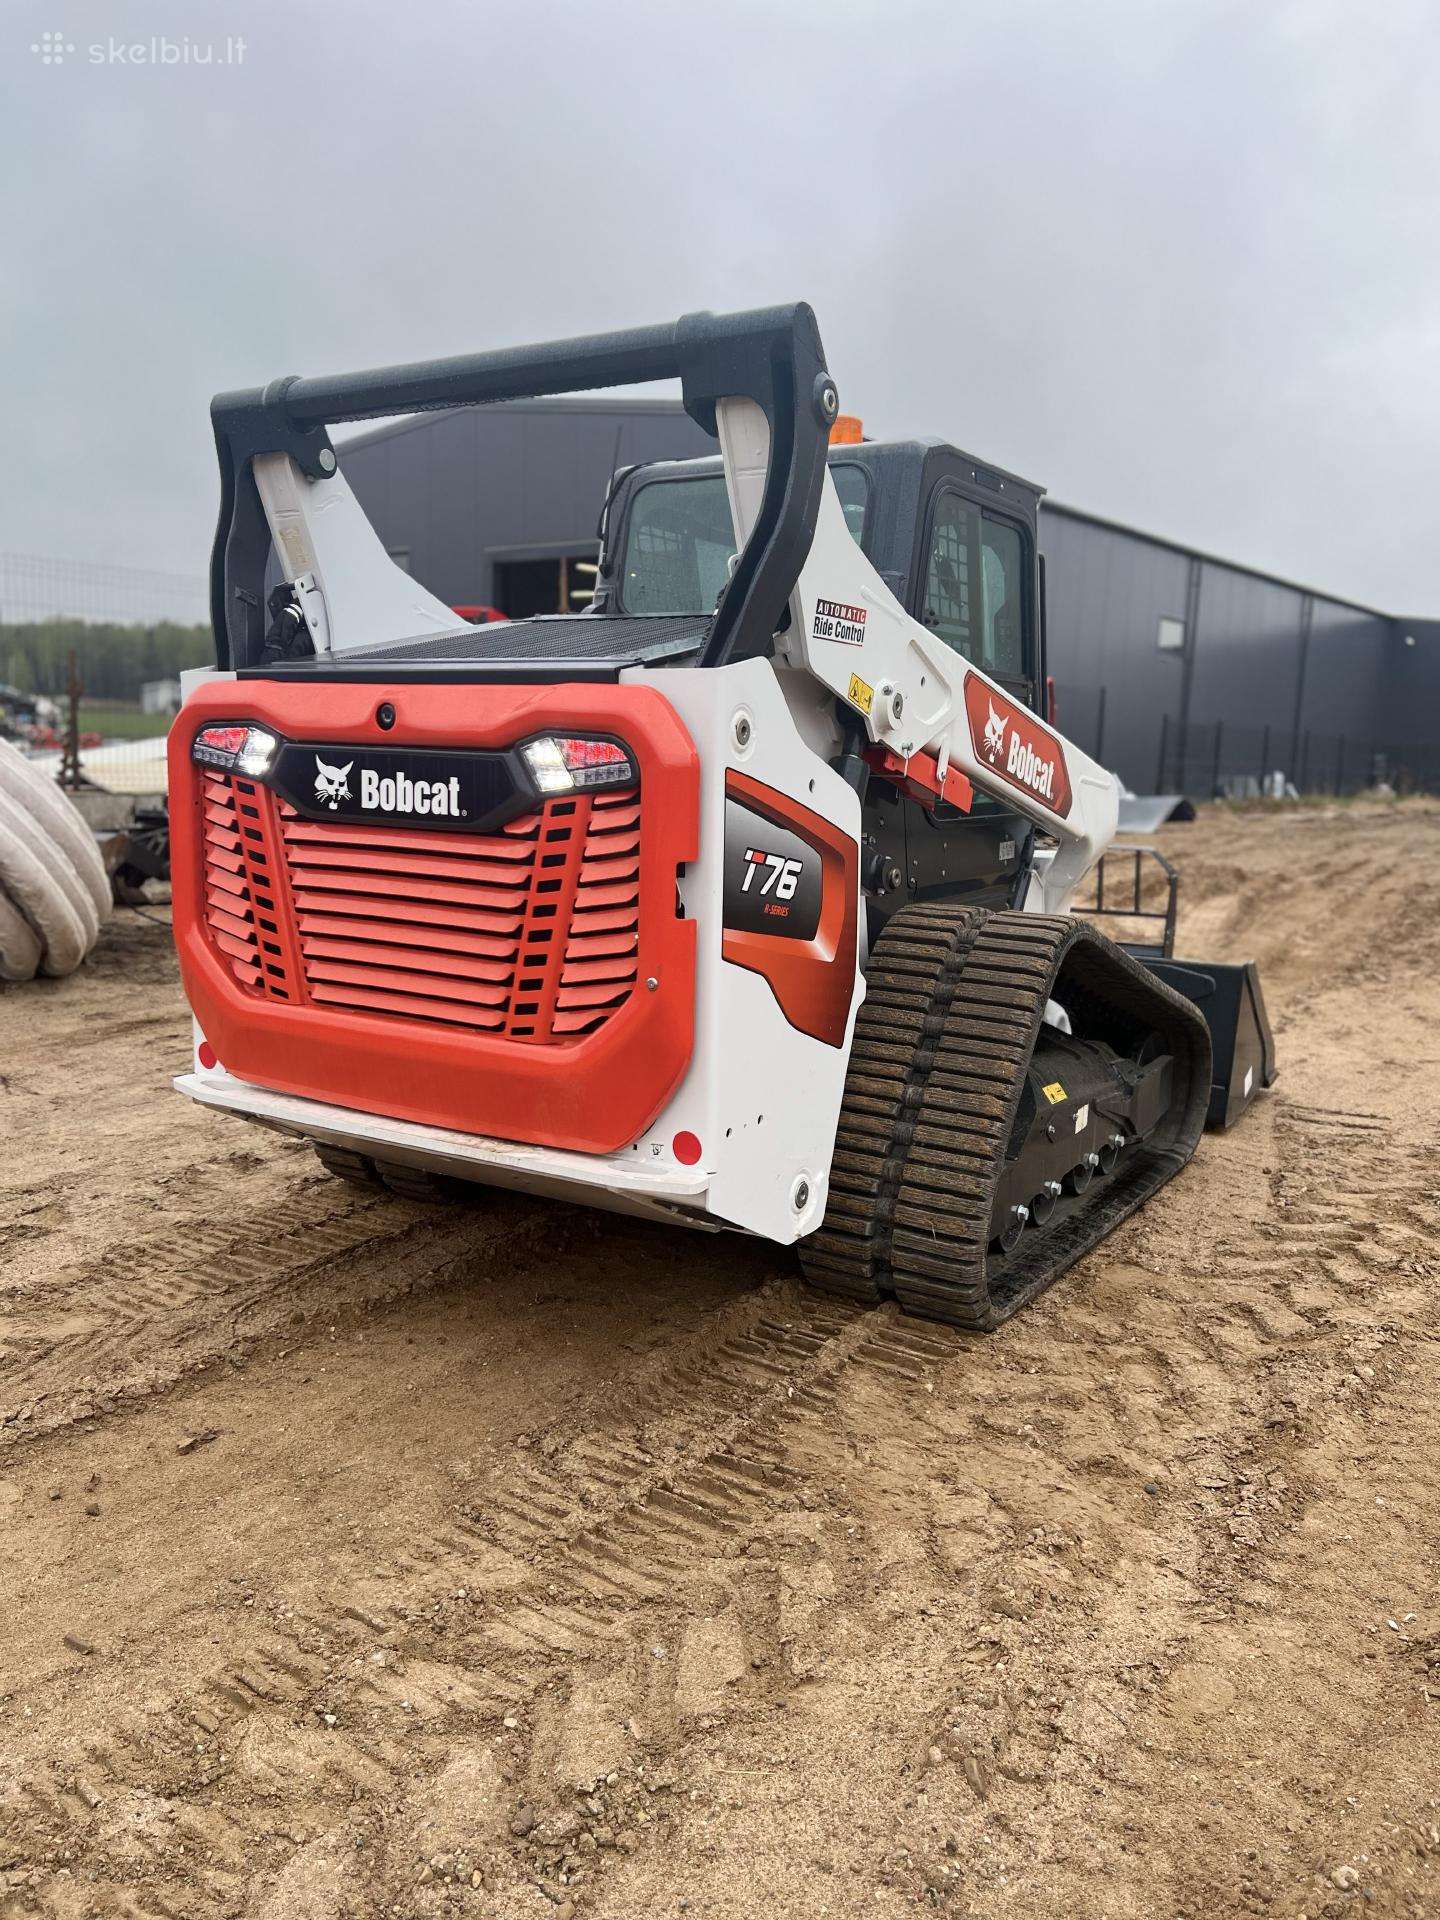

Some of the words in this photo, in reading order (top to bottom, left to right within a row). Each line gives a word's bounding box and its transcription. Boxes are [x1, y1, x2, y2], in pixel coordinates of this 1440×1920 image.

[813, 616, 833, 636] Ride
[835, 621, 865, 643] Control
[817, 602, 866, 622] AUTOMATIC
[1007, 730, 1054, 799] Bobcat
[361, 769, 460, 816] Bobcat
[741, 849, 803, 900] T76
[764, 903, 790, 917] R-SERIES
